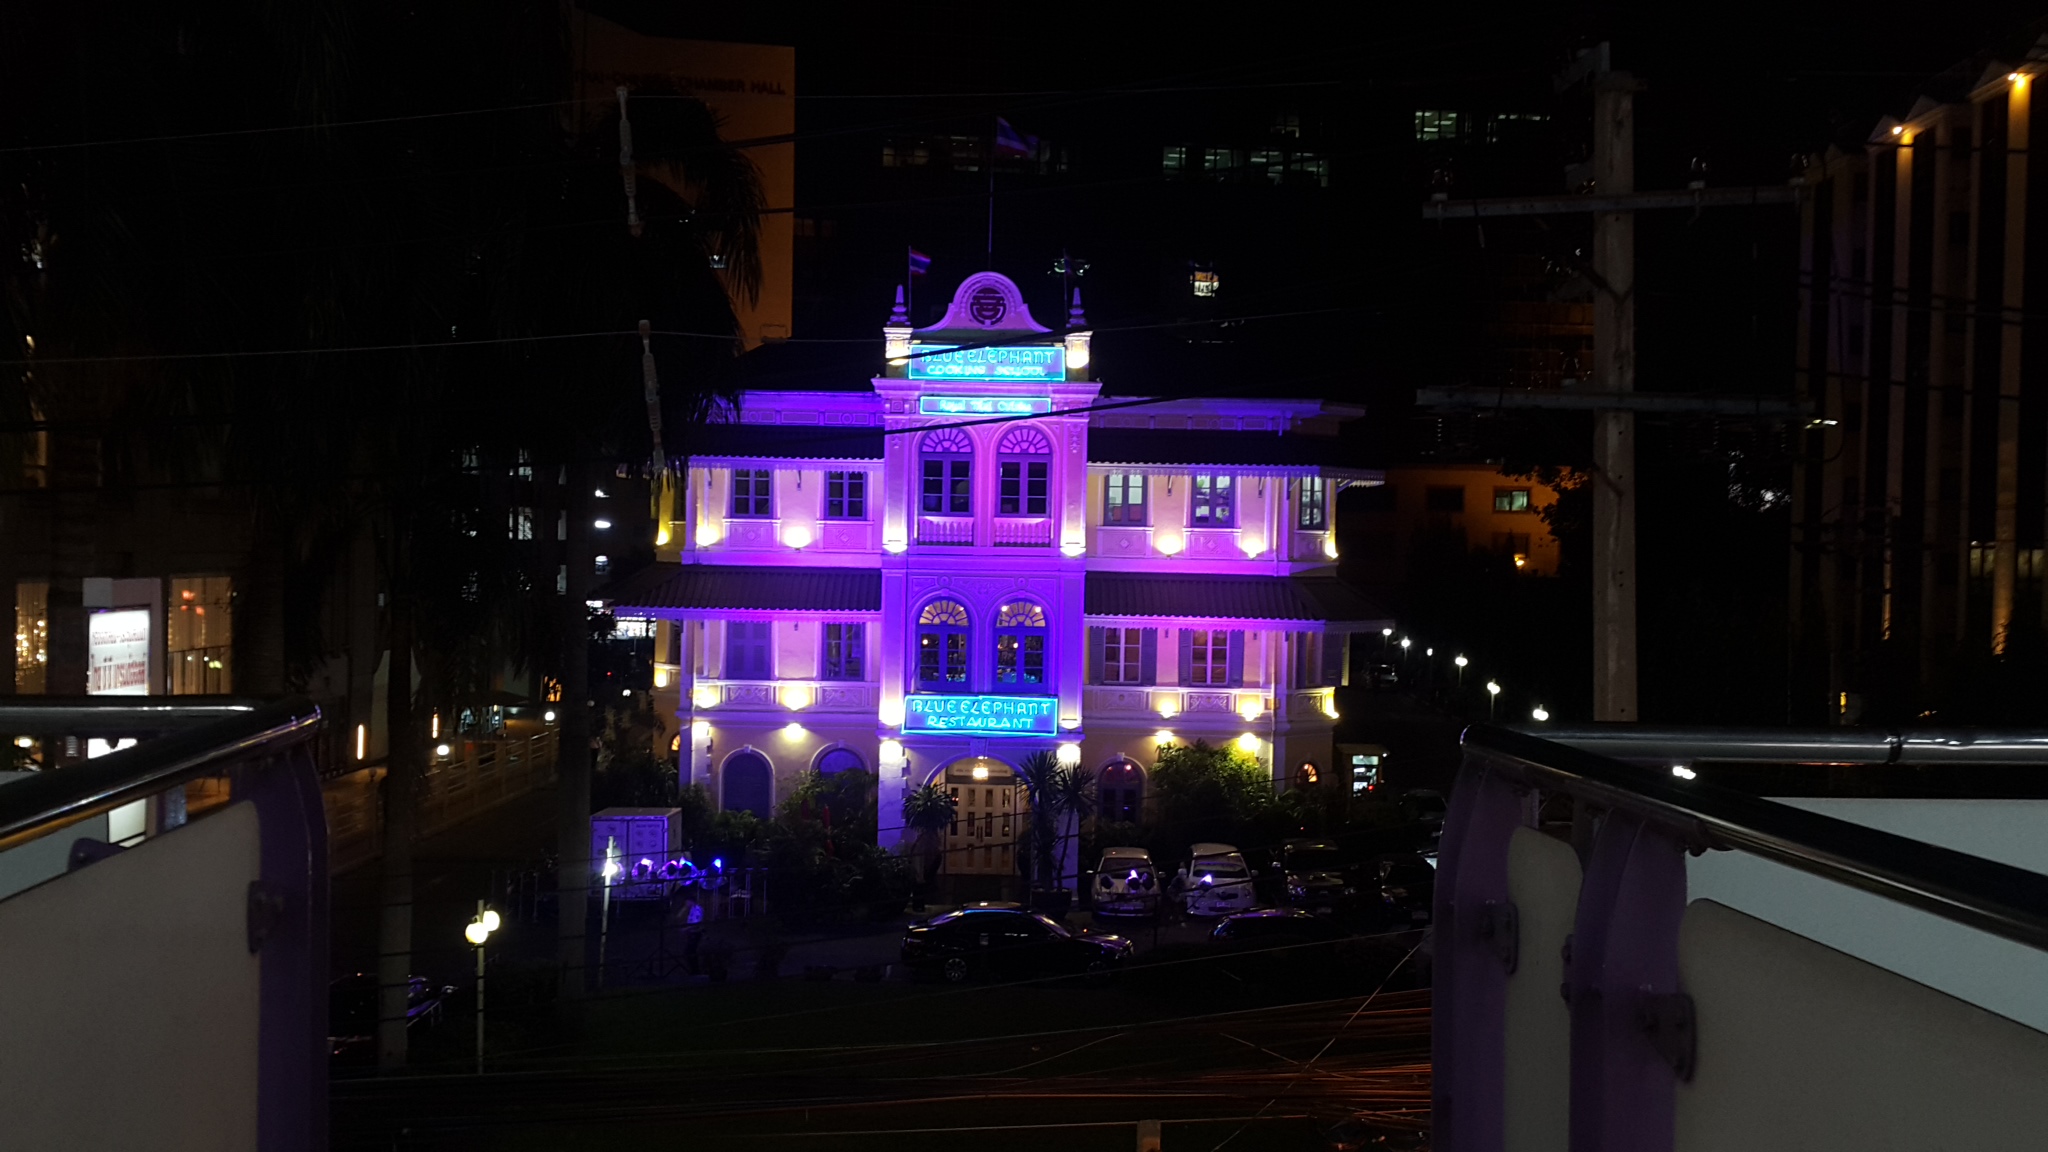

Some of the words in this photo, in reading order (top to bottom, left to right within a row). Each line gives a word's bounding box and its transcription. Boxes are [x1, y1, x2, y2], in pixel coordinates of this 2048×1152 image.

[679, 76, 745, 93] CHAMBER
[751, 80, 785, 95] HALL
[920, 350, 964, 363] BLUE
[967, 350, 1055, 364] ELEPHANT
[927, 365, 986, 375] COOKING
[995, 366, 1046, 376] SCHOOL
[939, 399, 966, 412] Royal
[912, 699, 957, 714] BLUE
[961, 701, 1051, 715] ELEPHANT
[926, 715, 1034, 729] RESTAURANT
